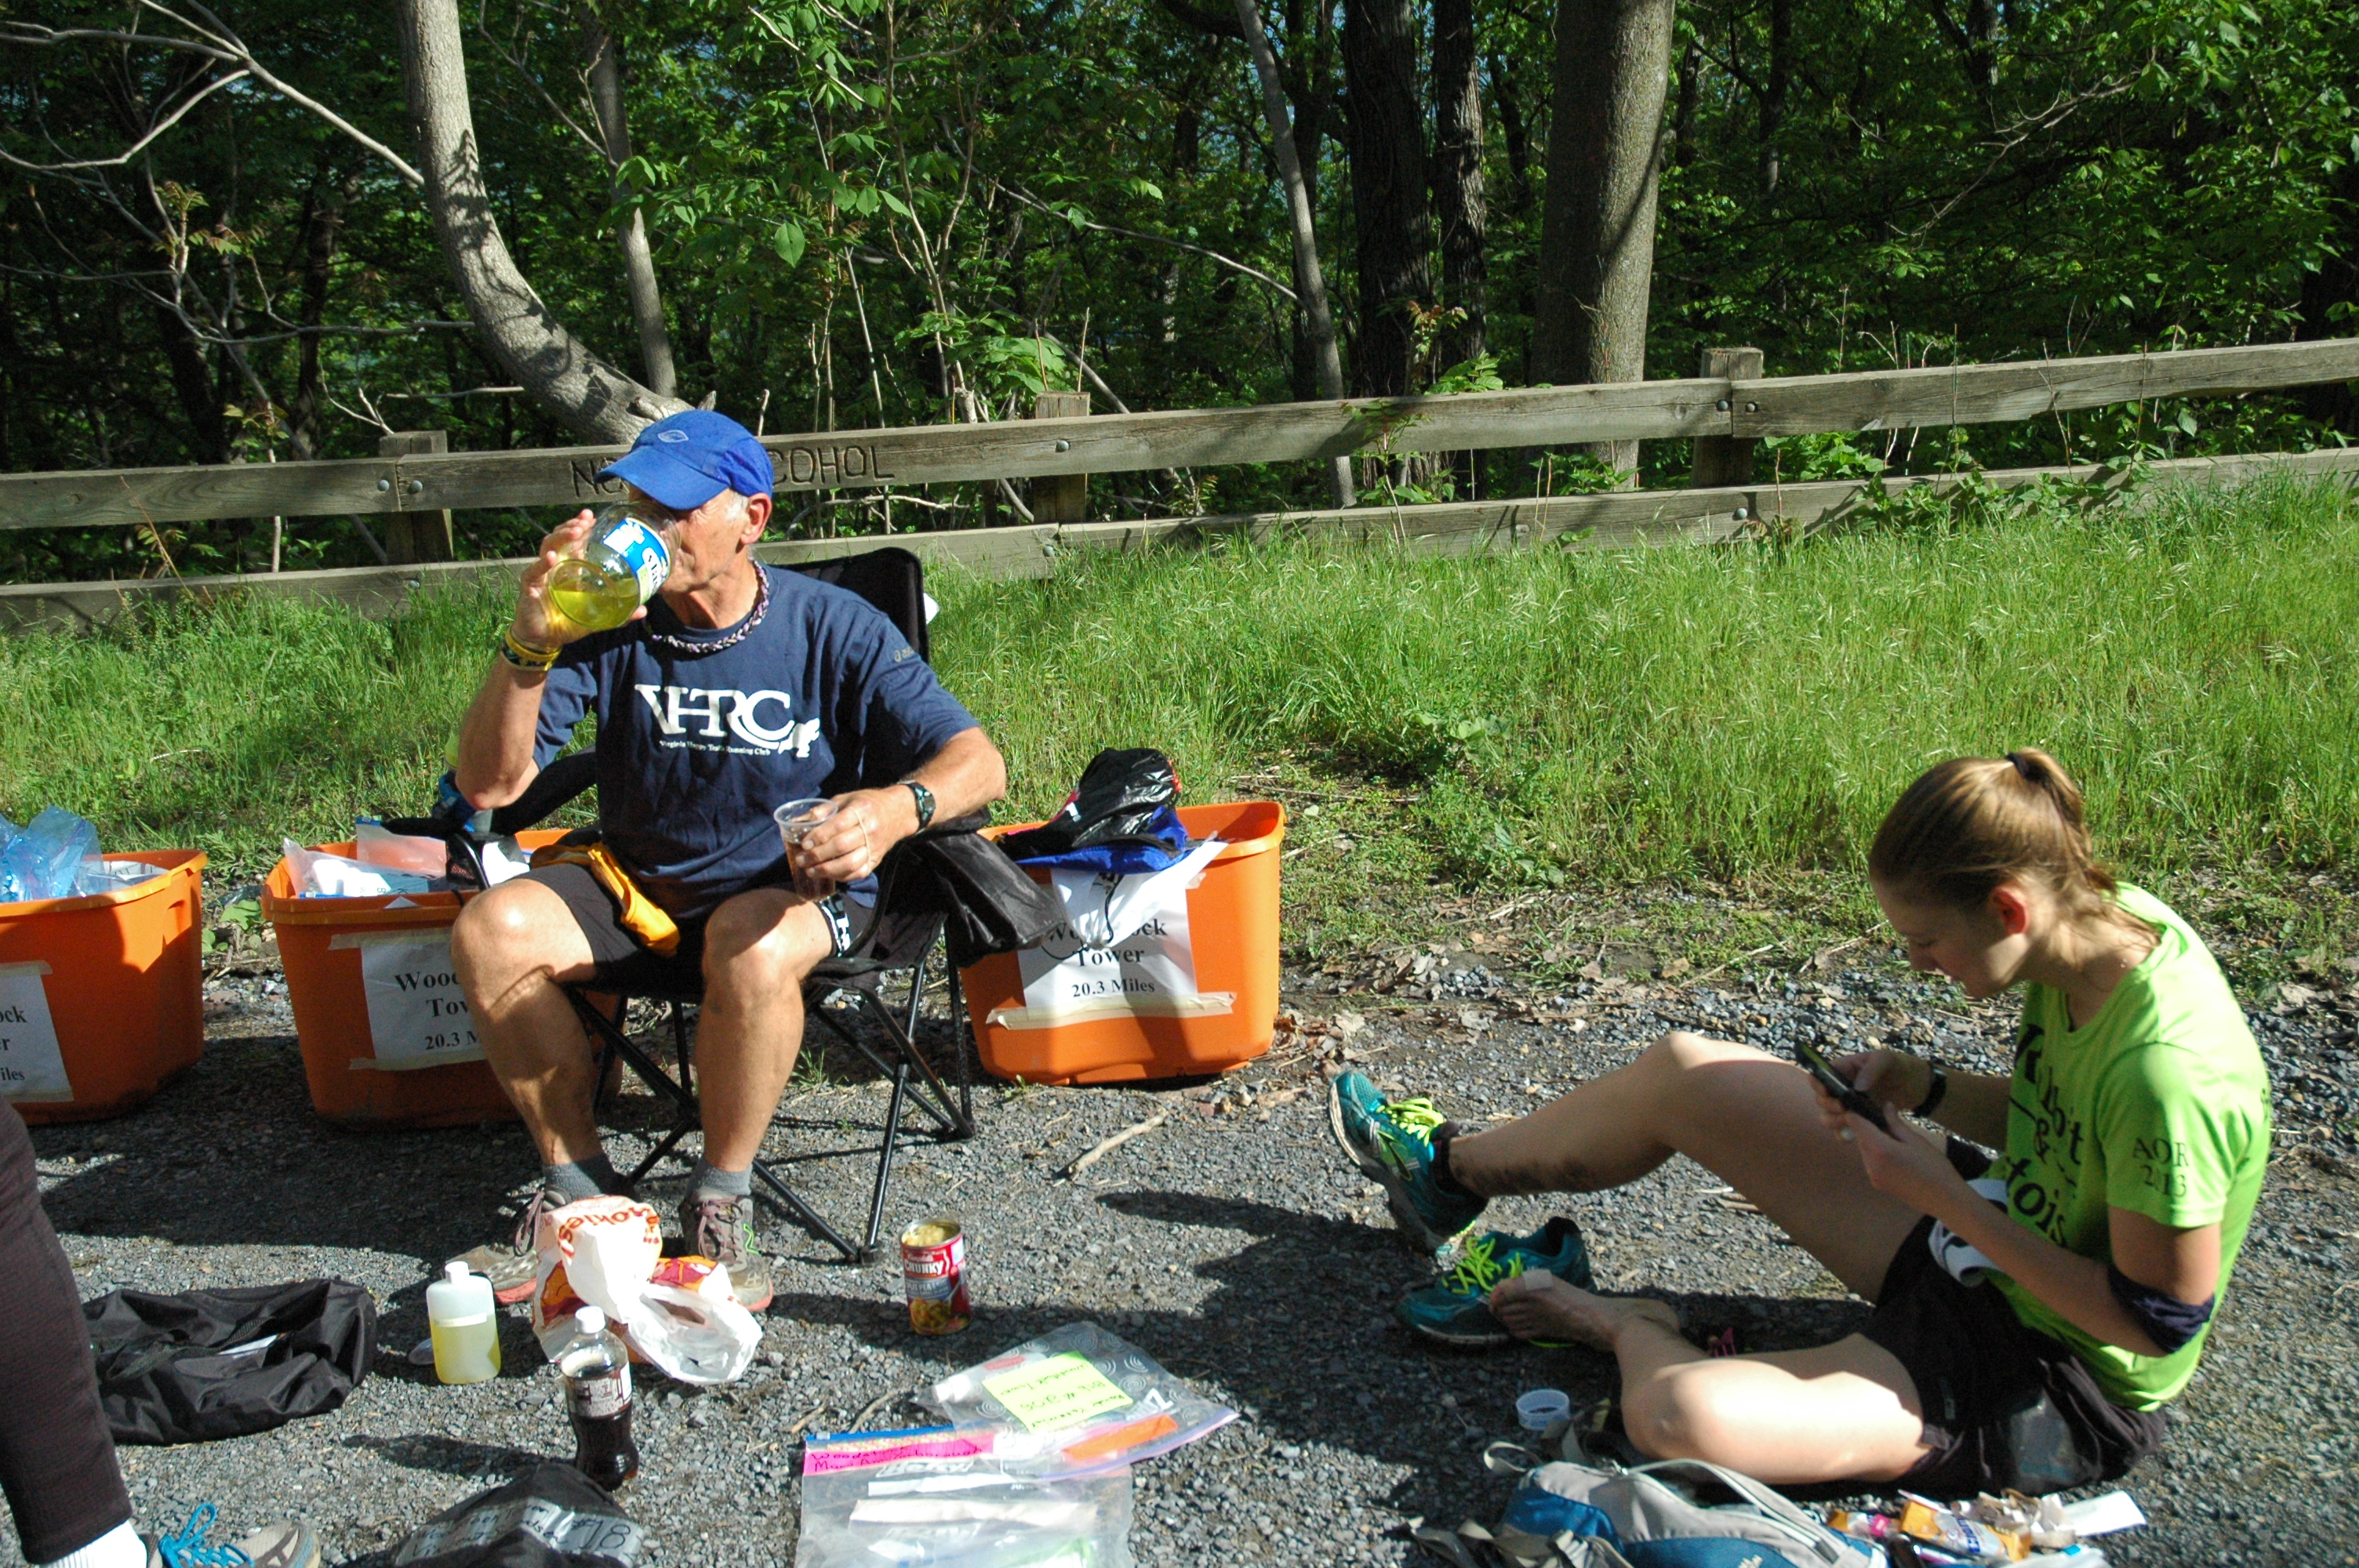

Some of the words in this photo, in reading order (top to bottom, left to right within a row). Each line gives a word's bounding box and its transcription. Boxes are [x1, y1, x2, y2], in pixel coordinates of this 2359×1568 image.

[770, 445, 895, 485] COHOL
[754, 747, 771, 756] Club
[1072, 946, 1145, 967] Tower
[1071, 980, 1106, 998] 20.3
[1111, 978, 1155, 993] Miles
[424, 1032, 461, 1051] 20.3
[2132, 1138, 2190, 1168] AOR
